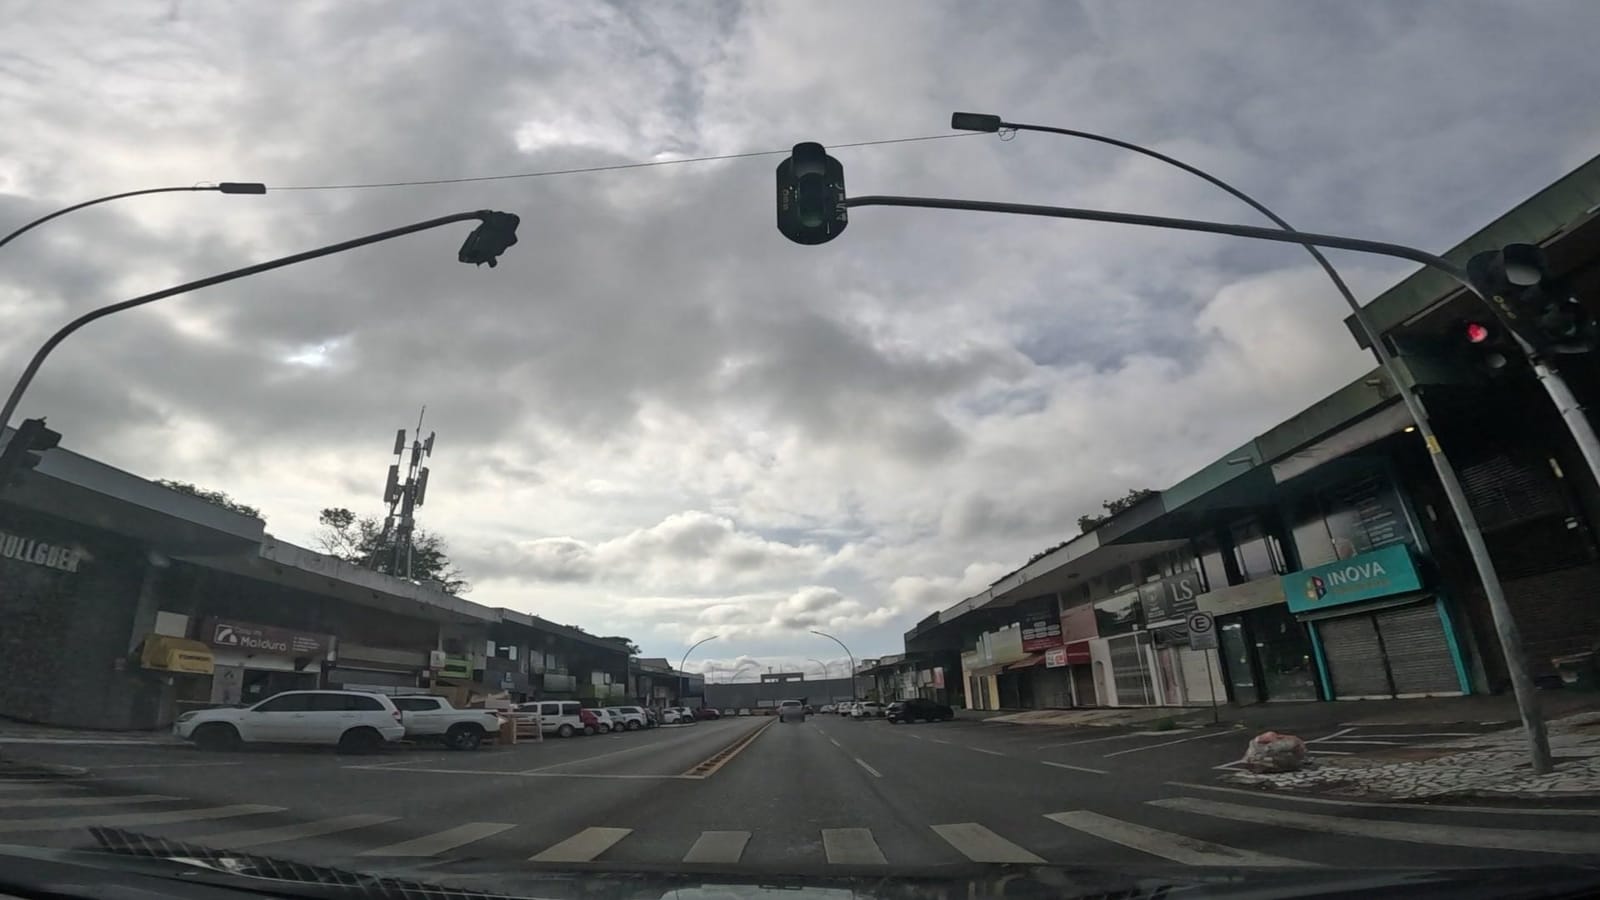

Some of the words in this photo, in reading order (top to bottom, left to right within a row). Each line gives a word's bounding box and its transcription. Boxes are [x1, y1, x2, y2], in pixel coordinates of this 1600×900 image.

[1327, 561, 1387, 586] INOVA
[1170, 579, 1193, 602] LS
[1195, 617, 1207, 630] E
